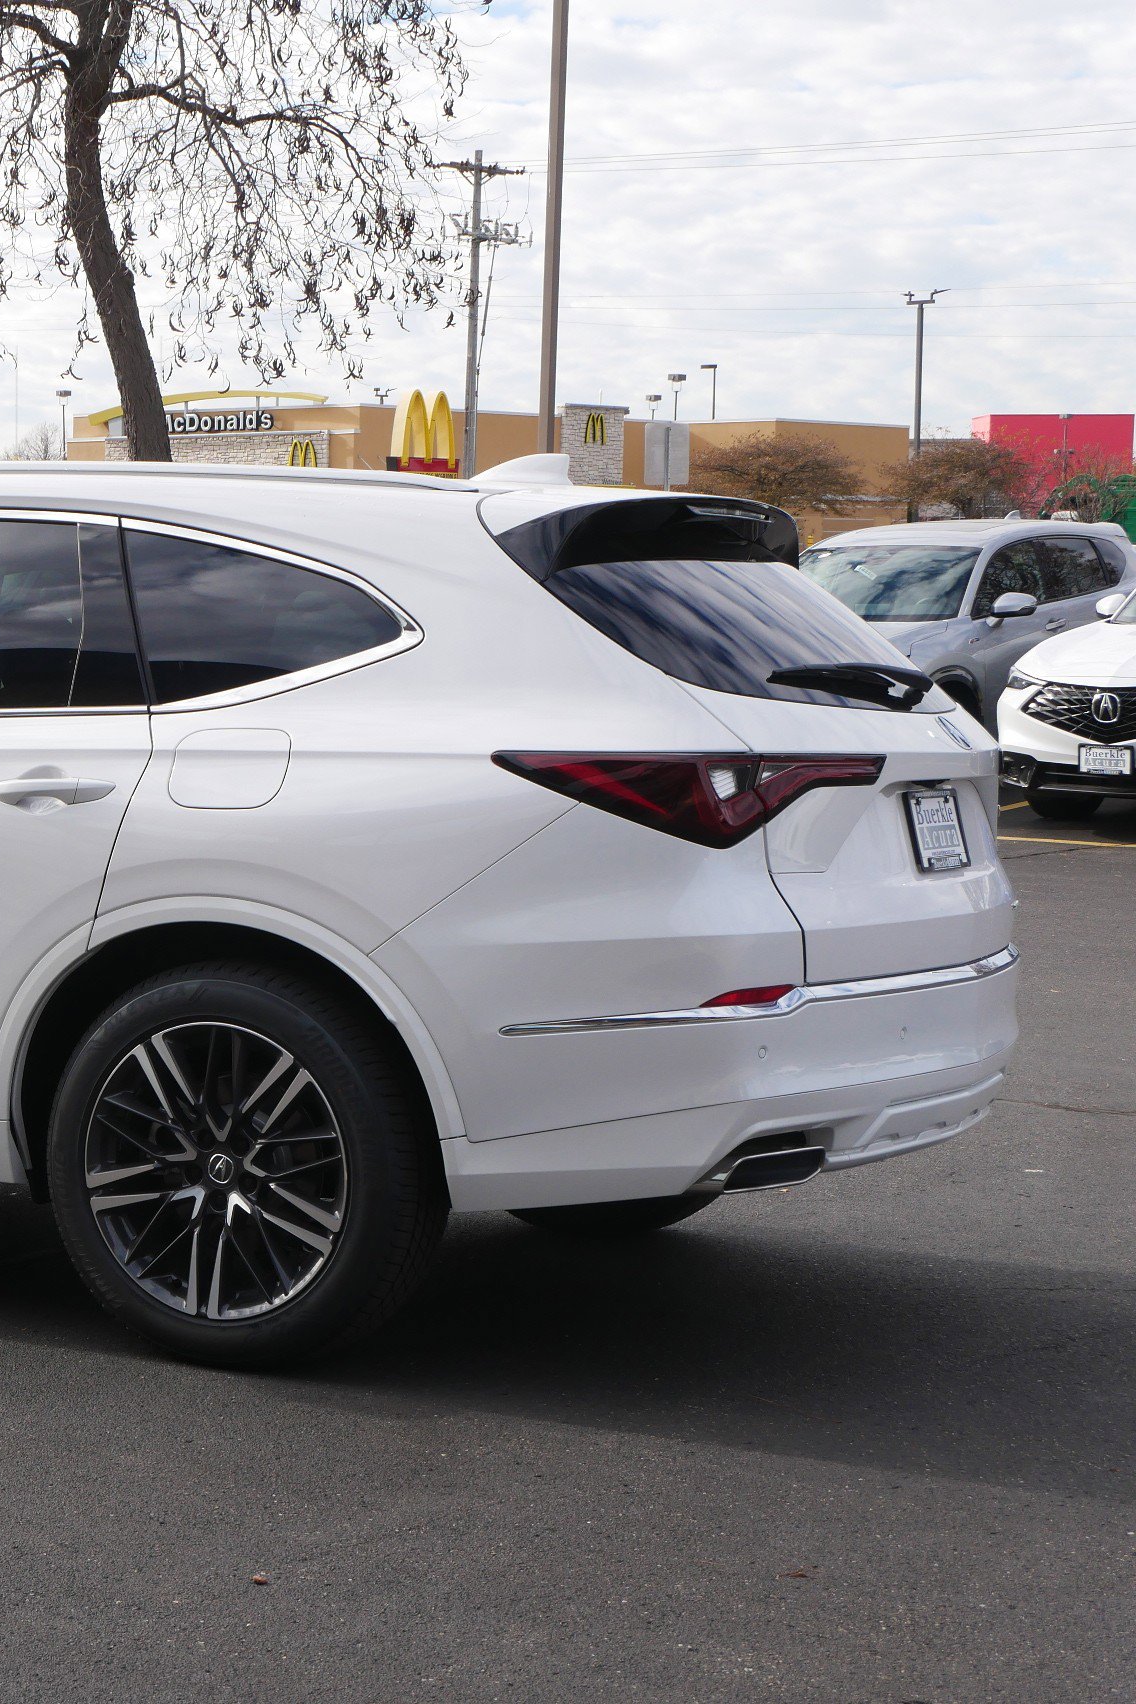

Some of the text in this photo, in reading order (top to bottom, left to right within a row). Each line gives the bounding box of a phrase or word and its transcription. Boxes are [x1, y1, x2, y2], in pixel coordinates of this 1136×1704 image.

[1085, 749, 1126, 758] Buerkle
[1086, 759, 1125, 767] Acura
[915, 801, 954, 826] Buerkle
[924, 826, 960, 848] Acura
